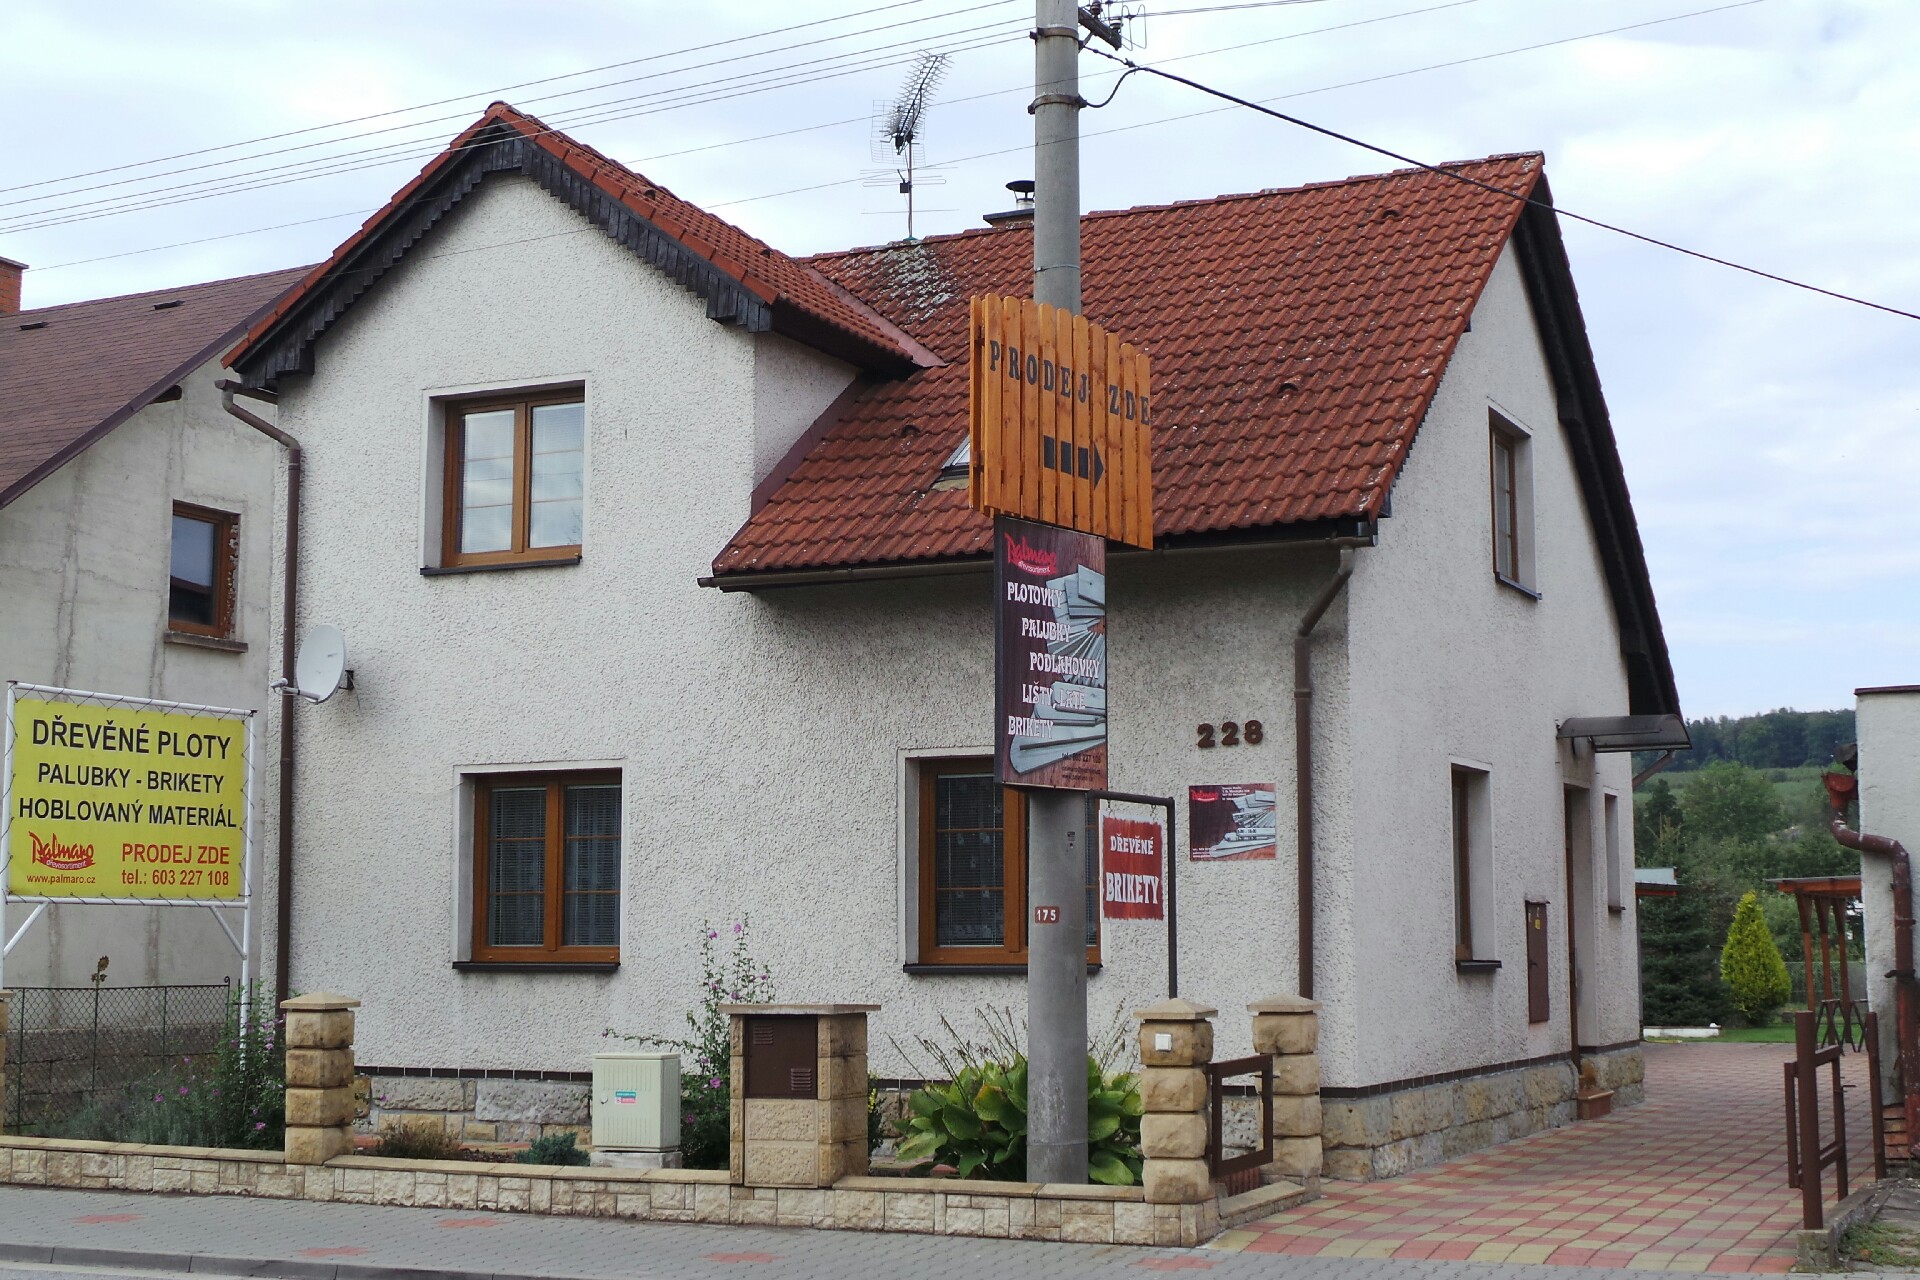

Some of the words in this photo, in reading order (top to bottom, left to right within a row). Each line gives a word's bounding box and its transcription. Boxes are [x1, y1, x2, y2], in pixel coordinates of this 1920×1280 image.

[989, 340, 1088, 403] PRODEJ
[1108, 384, 1150, 425] ZDE
[1007, 581, 1063, 609] PLOTOVKY
[1021, 617, 1070, 643] PALUBKY
[1029, 651, 1100, 679] PODLAHOVKY
[1022, 681, 1057, 709] LIŠTY,
[32, 714, 150, 754] DŘEVĚNÉ
[157, 730, 231, 760] PLOTY
[1008, 715, 1054, 739] BRIKETY
[1197, 720, 1264, 749] 228
[38, 762, 131, 788] PALUBKY
[147, 770, 225, 794] BRIKETY
[19, 797, 144, 824] HOBLOVANÝ
[148, 804, 237, 828] MATERIÁL
[28, 831, 94, 864] Palmaro
[121, 843, 192, 864] PRODEJ
[197, 846, 230, 865] ZDE
[1110, 833, 1154, 856] DŘEVĚNÉ
[27, 874, 96, 885] www.palmaro.cz
[121, 869, 147, 885] tel.:
[152, 869, 176, 886] 603
[179, 870, 203, 886] 227
[207, 870, 229, 886] 108
[1106, 872, 1159, 905] BRIKETY
[1036, 909, 1056, 921] 175
